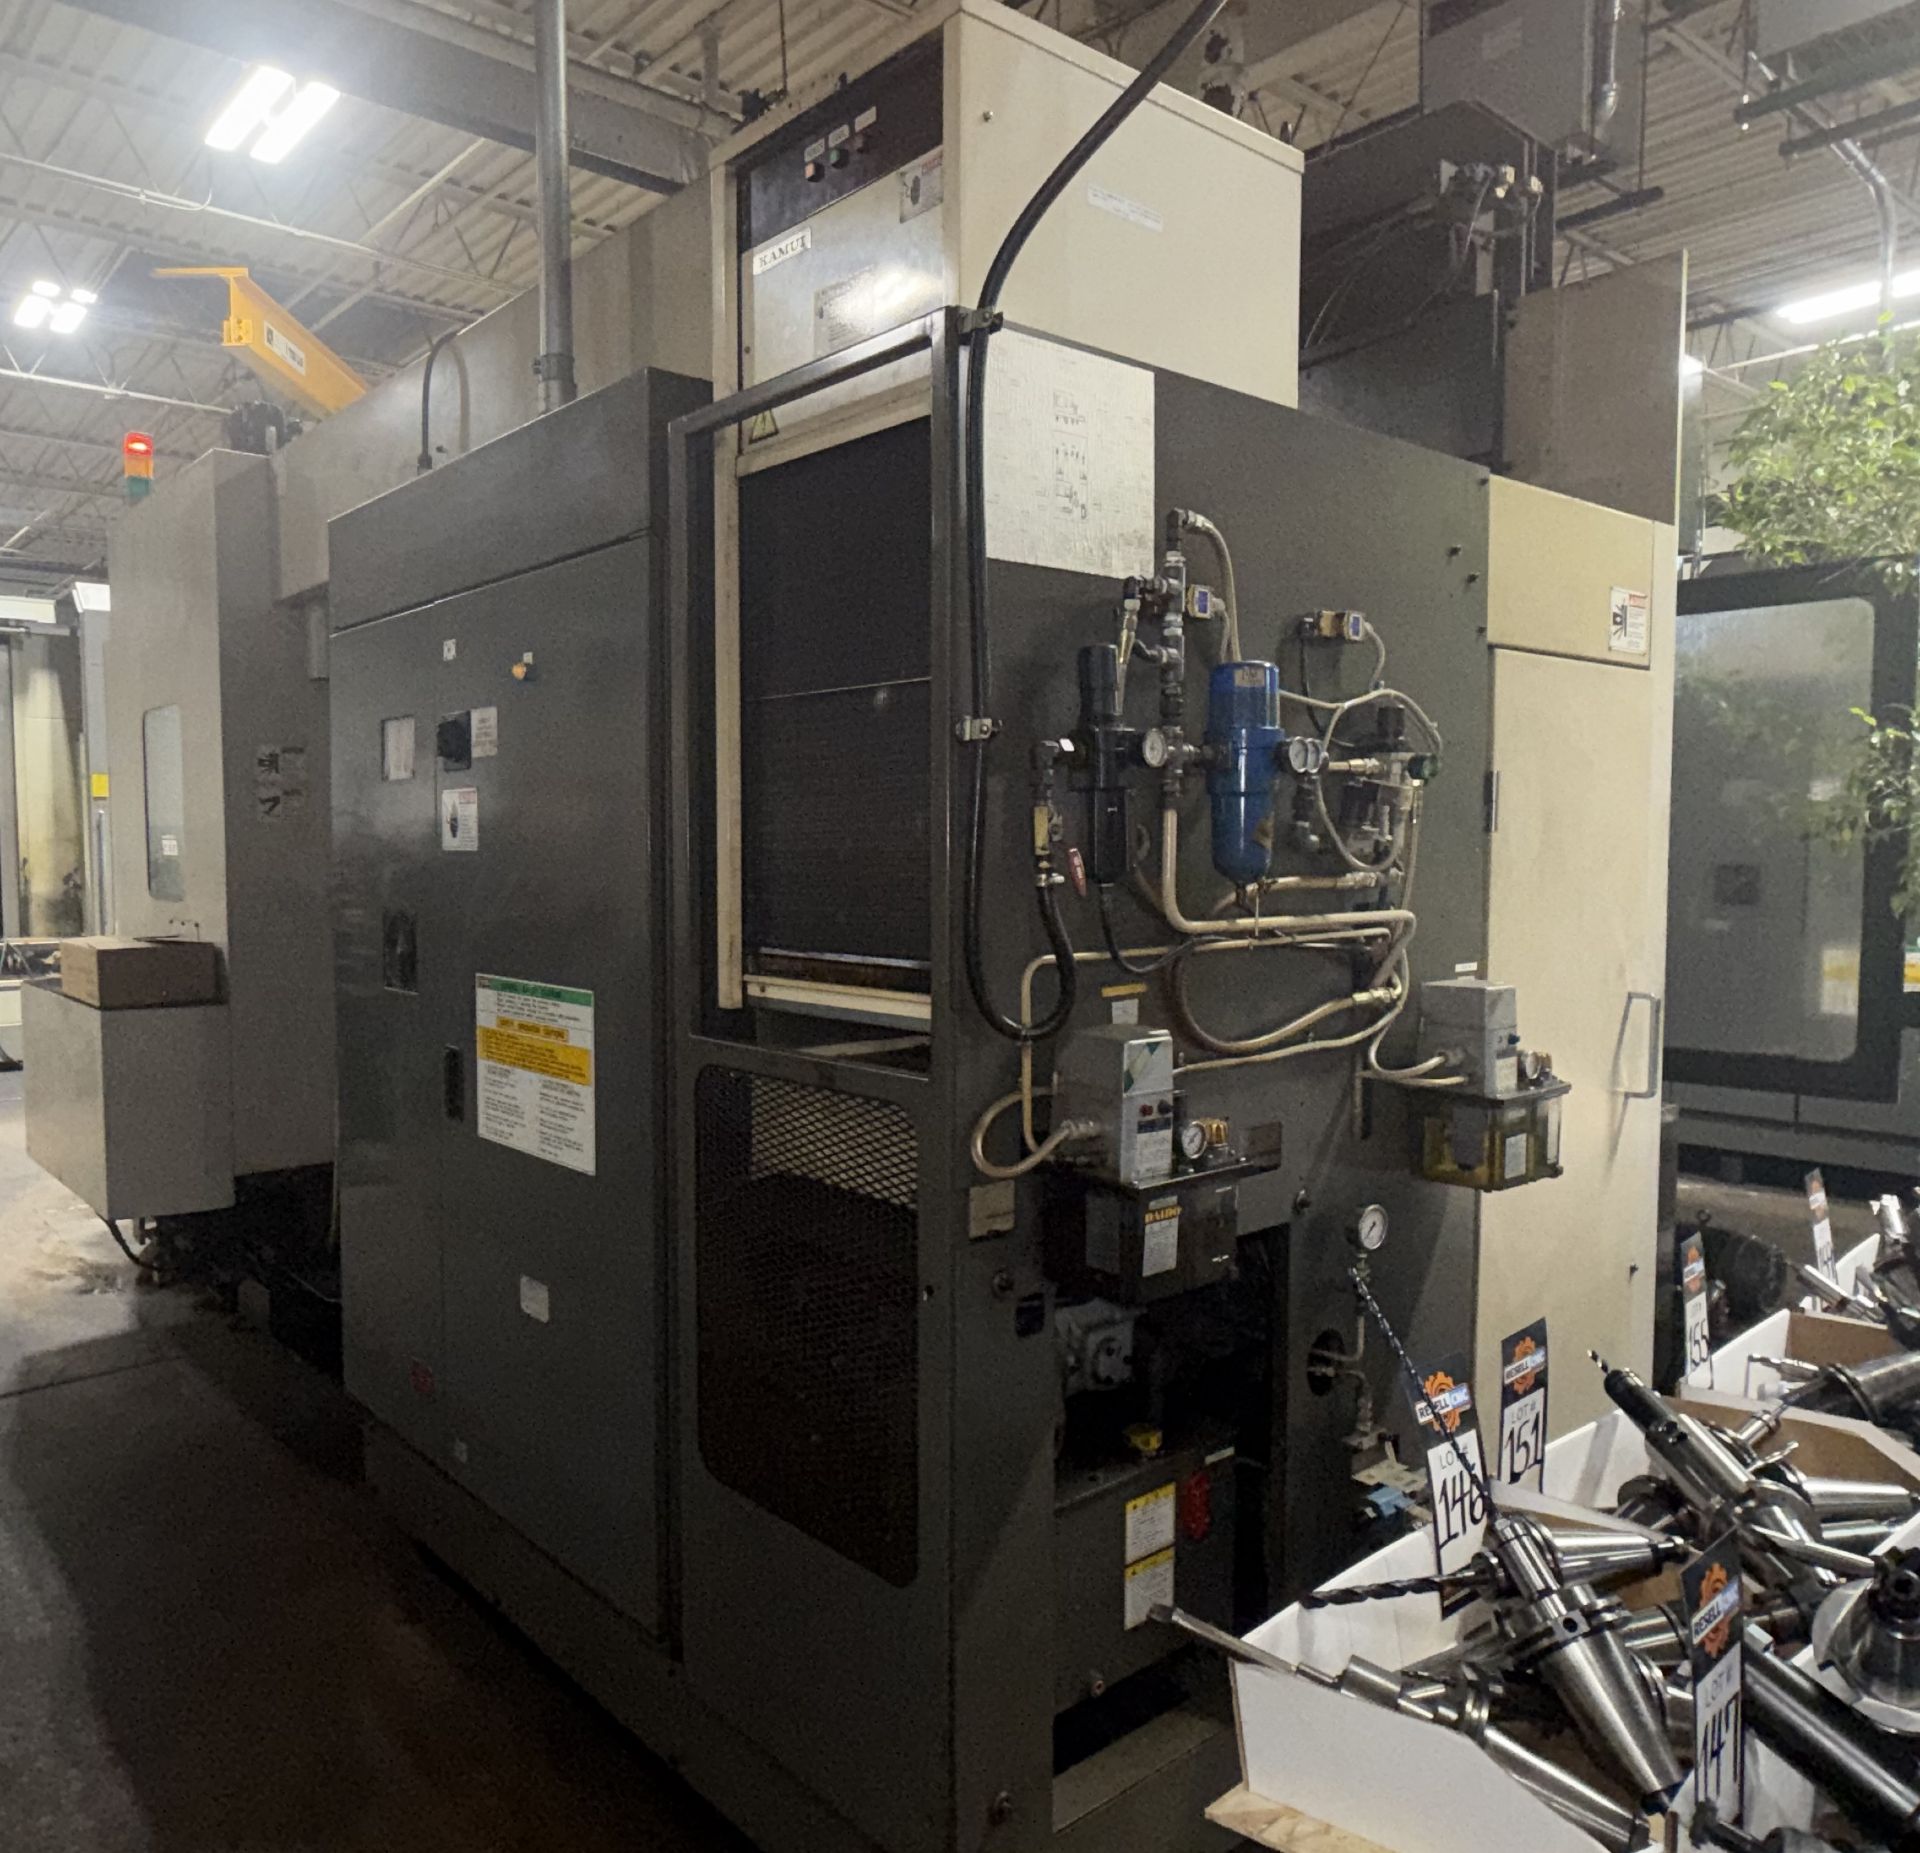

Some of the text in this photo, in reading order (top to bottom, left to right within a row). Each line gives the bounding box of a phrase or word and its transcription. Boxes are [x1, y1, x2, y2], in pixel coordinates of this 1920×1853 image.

[759, 234, 806, 268] KAMUI
[1417, 1397, 1450, 1419] REELL
[1511, 1404, 1529, 1424] LOT
[1504, 1411, 1543, 1485] 151
[1703, 1671, 1725, 1708] LOT
